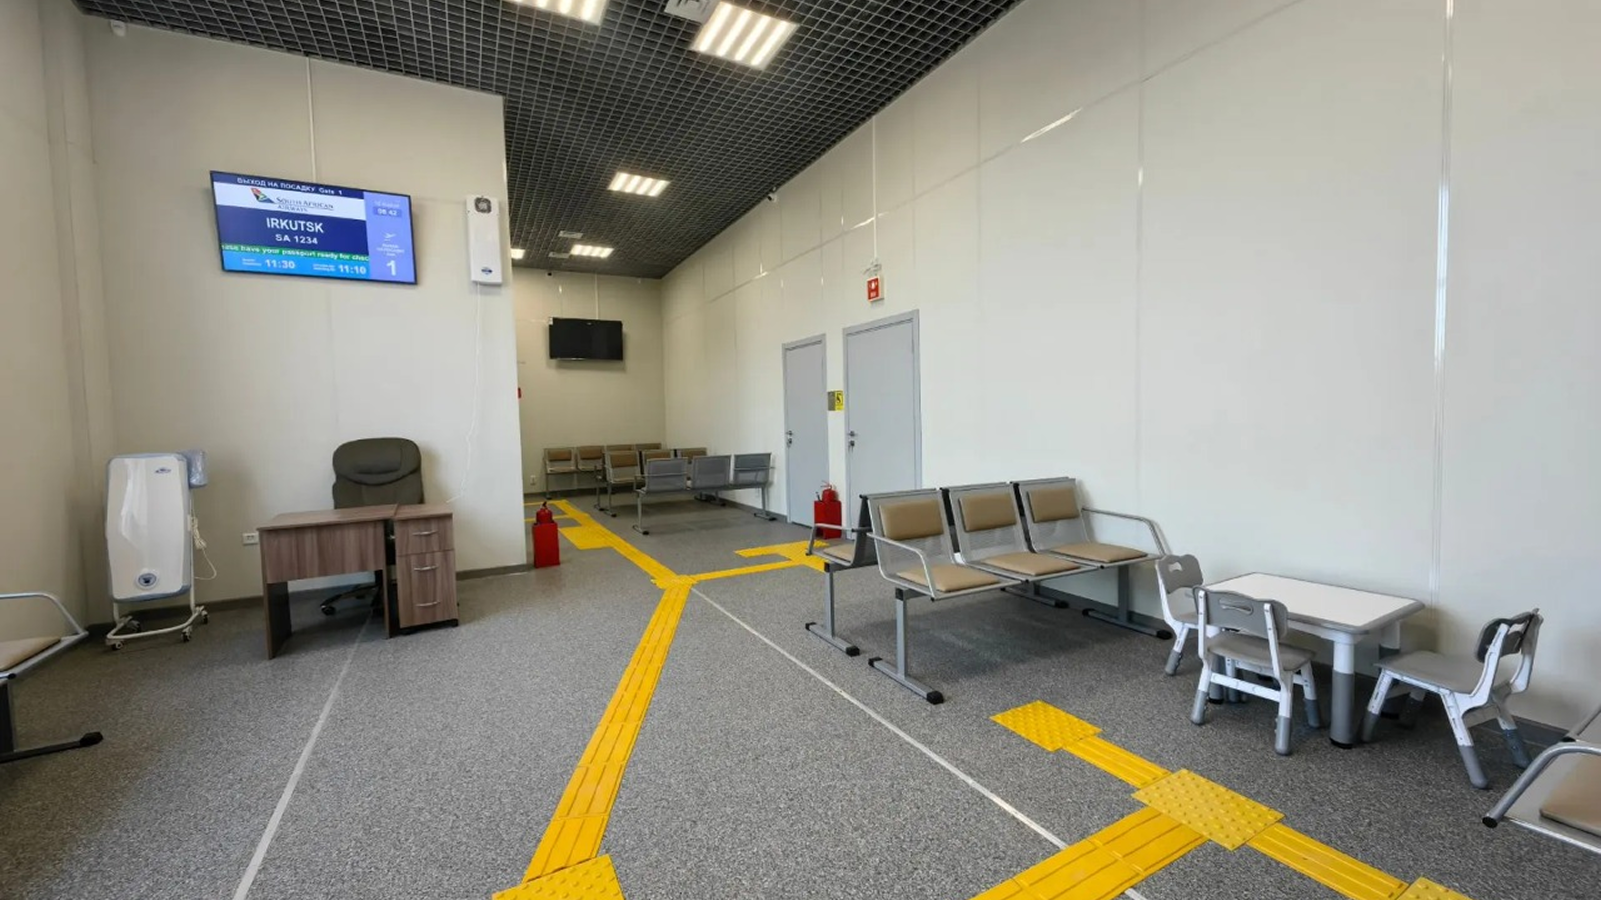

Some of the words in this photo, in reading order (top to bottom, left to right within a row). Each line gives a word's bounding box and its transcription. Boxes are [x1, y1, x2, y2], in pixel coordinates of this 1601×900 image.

[237, 178, 266, 186] ВЫХОД
[280, 182, 315, 192] ПОСАДКУ
[266, 217, 324, 233] IRKUTSK
[275, 233, 291, 242] SA
[294, 235, 318, 244] 1234
[240, 245, 260, 253] have
[281, 249, 316, 258] passport
[317, 251, 338, 260] ready
[265, 259, 295, 269] 11:30
[339, 265, 366, 274] 11:10
[386, 260, 396, 276] 1
